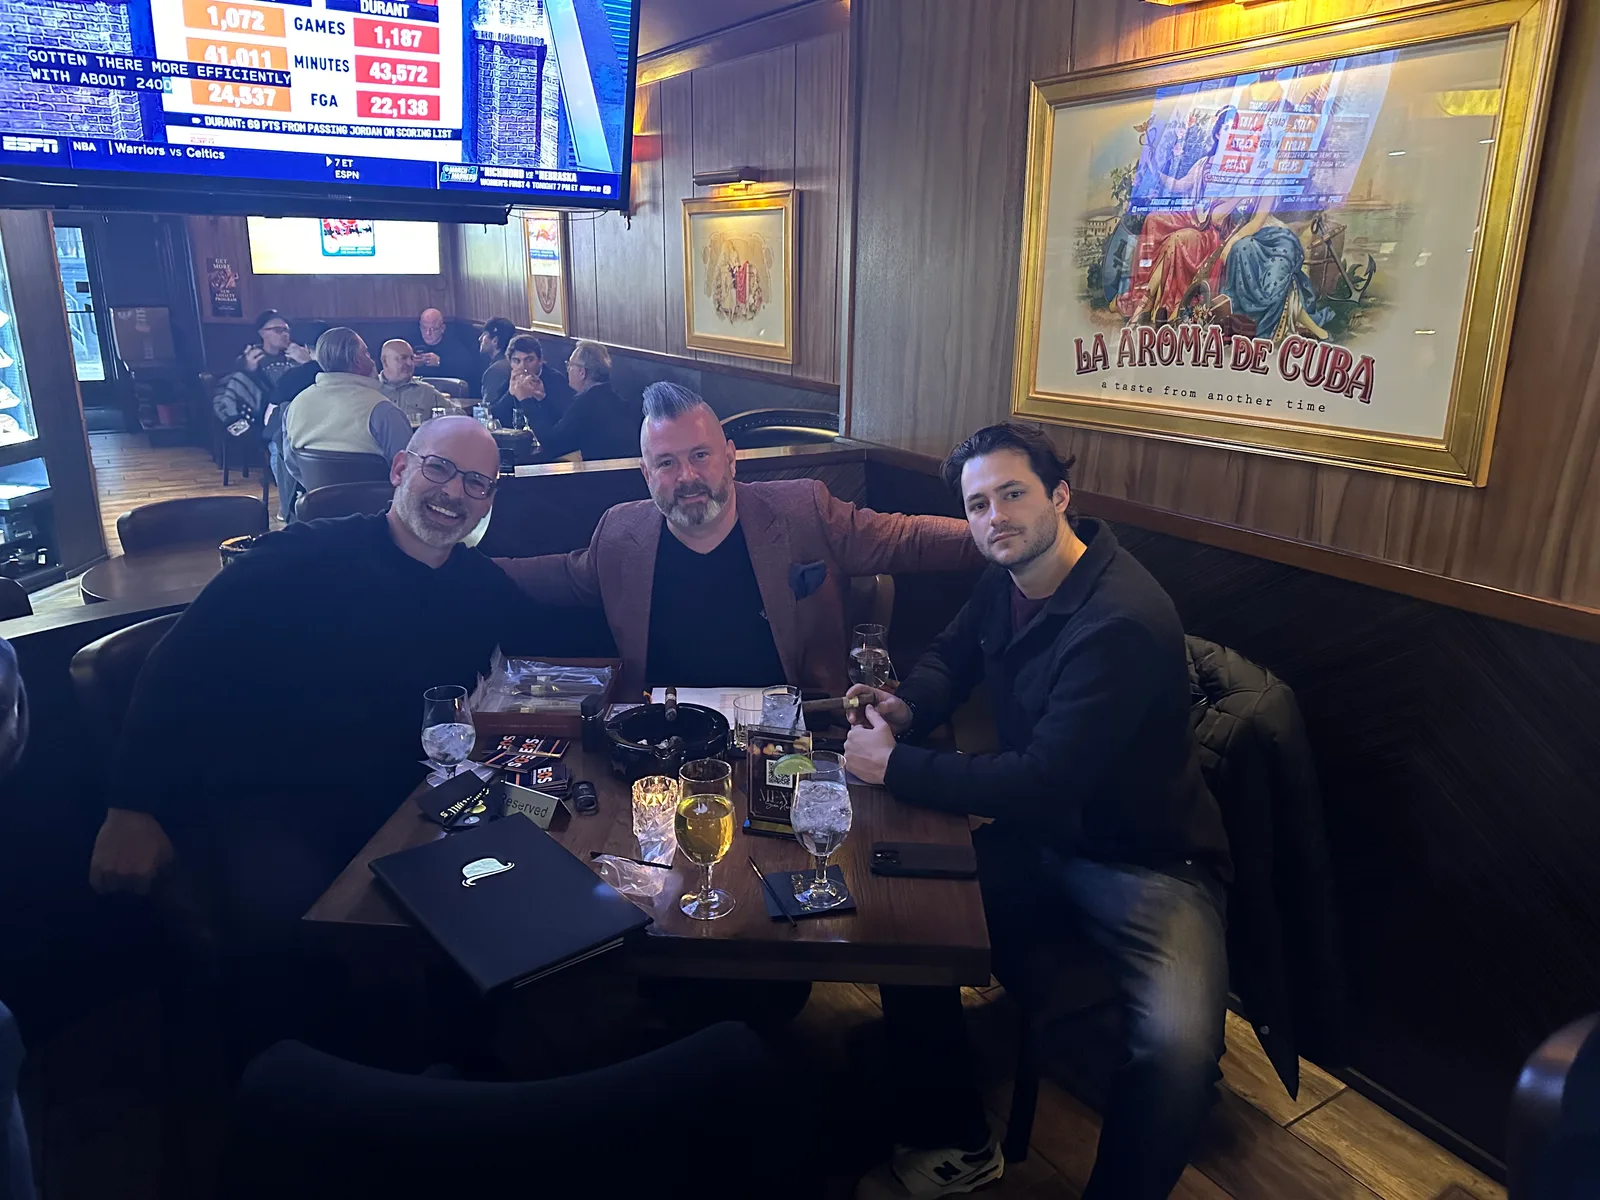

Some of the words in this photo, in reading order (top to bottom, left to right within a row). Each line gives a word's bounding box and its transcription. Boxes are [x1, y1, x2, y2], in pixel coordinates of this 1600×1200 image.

[206, 5, 265, 31] 1,072
[360, 0, 409, 18] DURANT
[294, 17, 346, 35] GAMES
[374, 26, 422, 48] 1,187
[28, 49, 87, 66] GOTTEN
[95, 55, 144, 72] THERE
[151, 61, 188, 76] MORE
[197, 66, 291, 84] EFFICIENTLY
[294, 55, 350, 72] MINUTES
[369, 62, 428, 84] 43,572
[30, 68, 71, 82] WITH
[80, 72, 126, 87] ABOUT
[207, 83, 277, 108] 24,537
[311, 93, 338, 107] FGA
[370, 96, 429, 118] 22,138
[204, 116, 246, 129] DURANT:
[262, 120, 280, 131] PTS
[282, 121, 306, 133] FROM
[307, 123, 348, 135] PASSING
[350, 125, 382, 137] JORDAN
[384, 127, 395, 137] ON
[396, 128, 431, 138] SCORING
[433, 129, 452, 139] LIST
[3, 136, 58, 153] ESPN
[73, 141, 97, 152] NBA
[115, 142, 166, 156] Warriors
[169, 149, 182, 157] vs
[186, 147, 225, 160] Celtics
[335, 158, 340, 167] 7
[342, 159, 353, 168] ET
[335, 170, 359, 180] ESPN
[1073, 333, 1110, 375] LA
[1116, 324, 1224, 369] AROMA
[1230, 334, 1273, 375] DE
[1278, 333, 1377, 404] CUBA
[1101, 381, 1108, 390] a
[1115, 381, 1153, 394] taste
[1163, 385, 1197, 399] from
[1207, 391, 1273, 407] another
[1286, 398, 1327, 413] time
